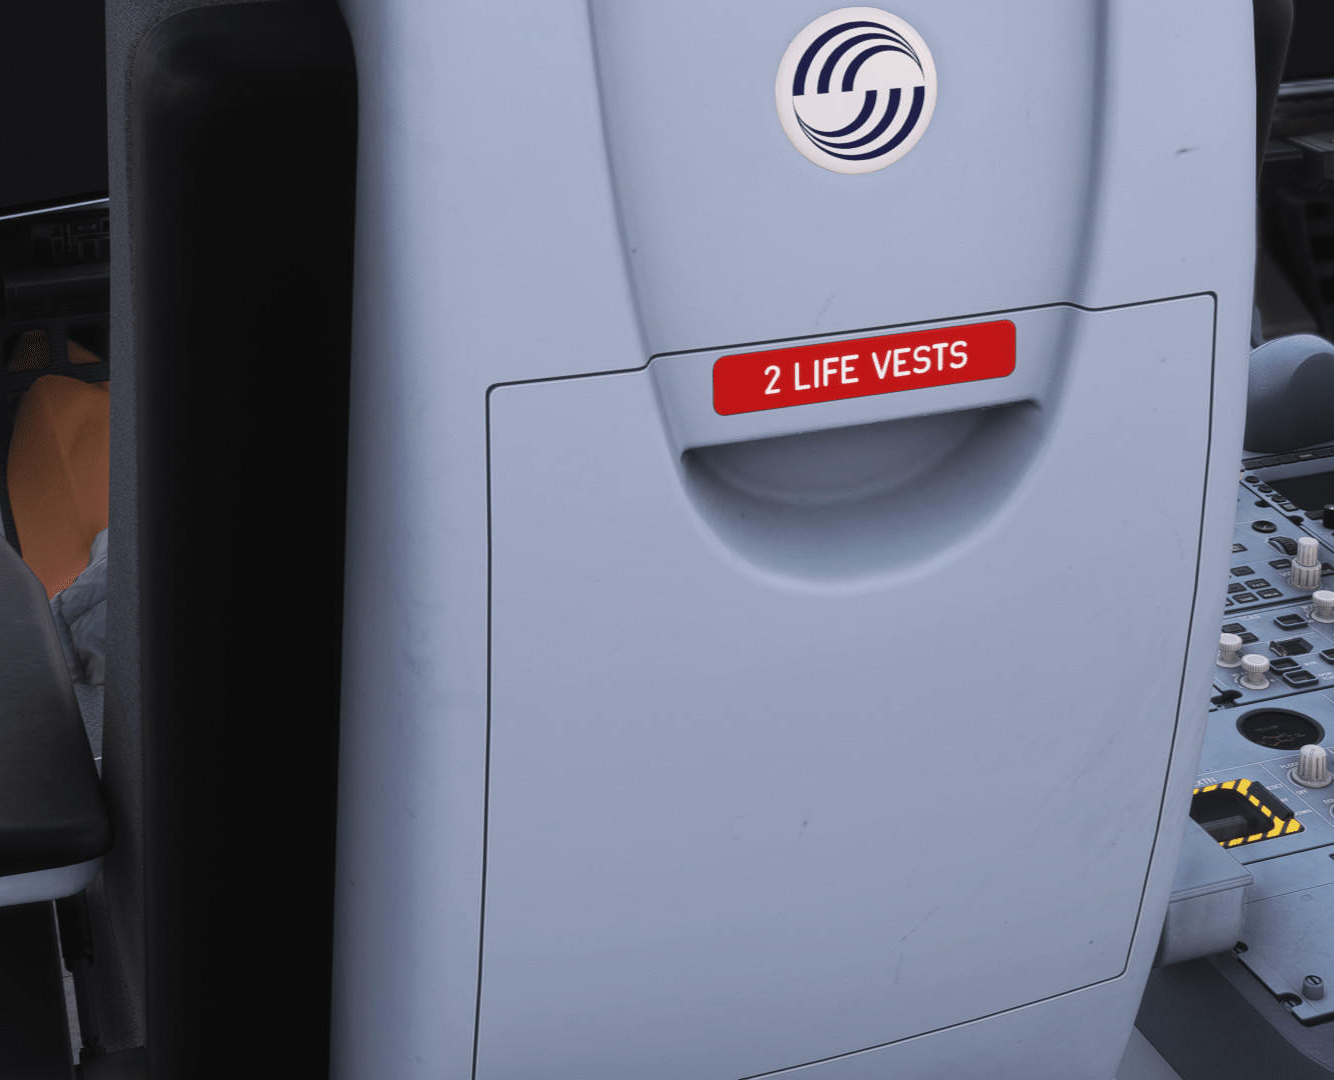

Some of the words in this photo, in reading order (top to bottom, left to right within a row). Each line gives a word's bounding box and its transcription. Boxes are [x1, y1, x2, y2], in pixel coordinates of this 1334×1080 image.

[764, 365, 781, 395] 2
[794, 354, 859, 391] LIFE
[871, 341, 968, 379] VESTS
